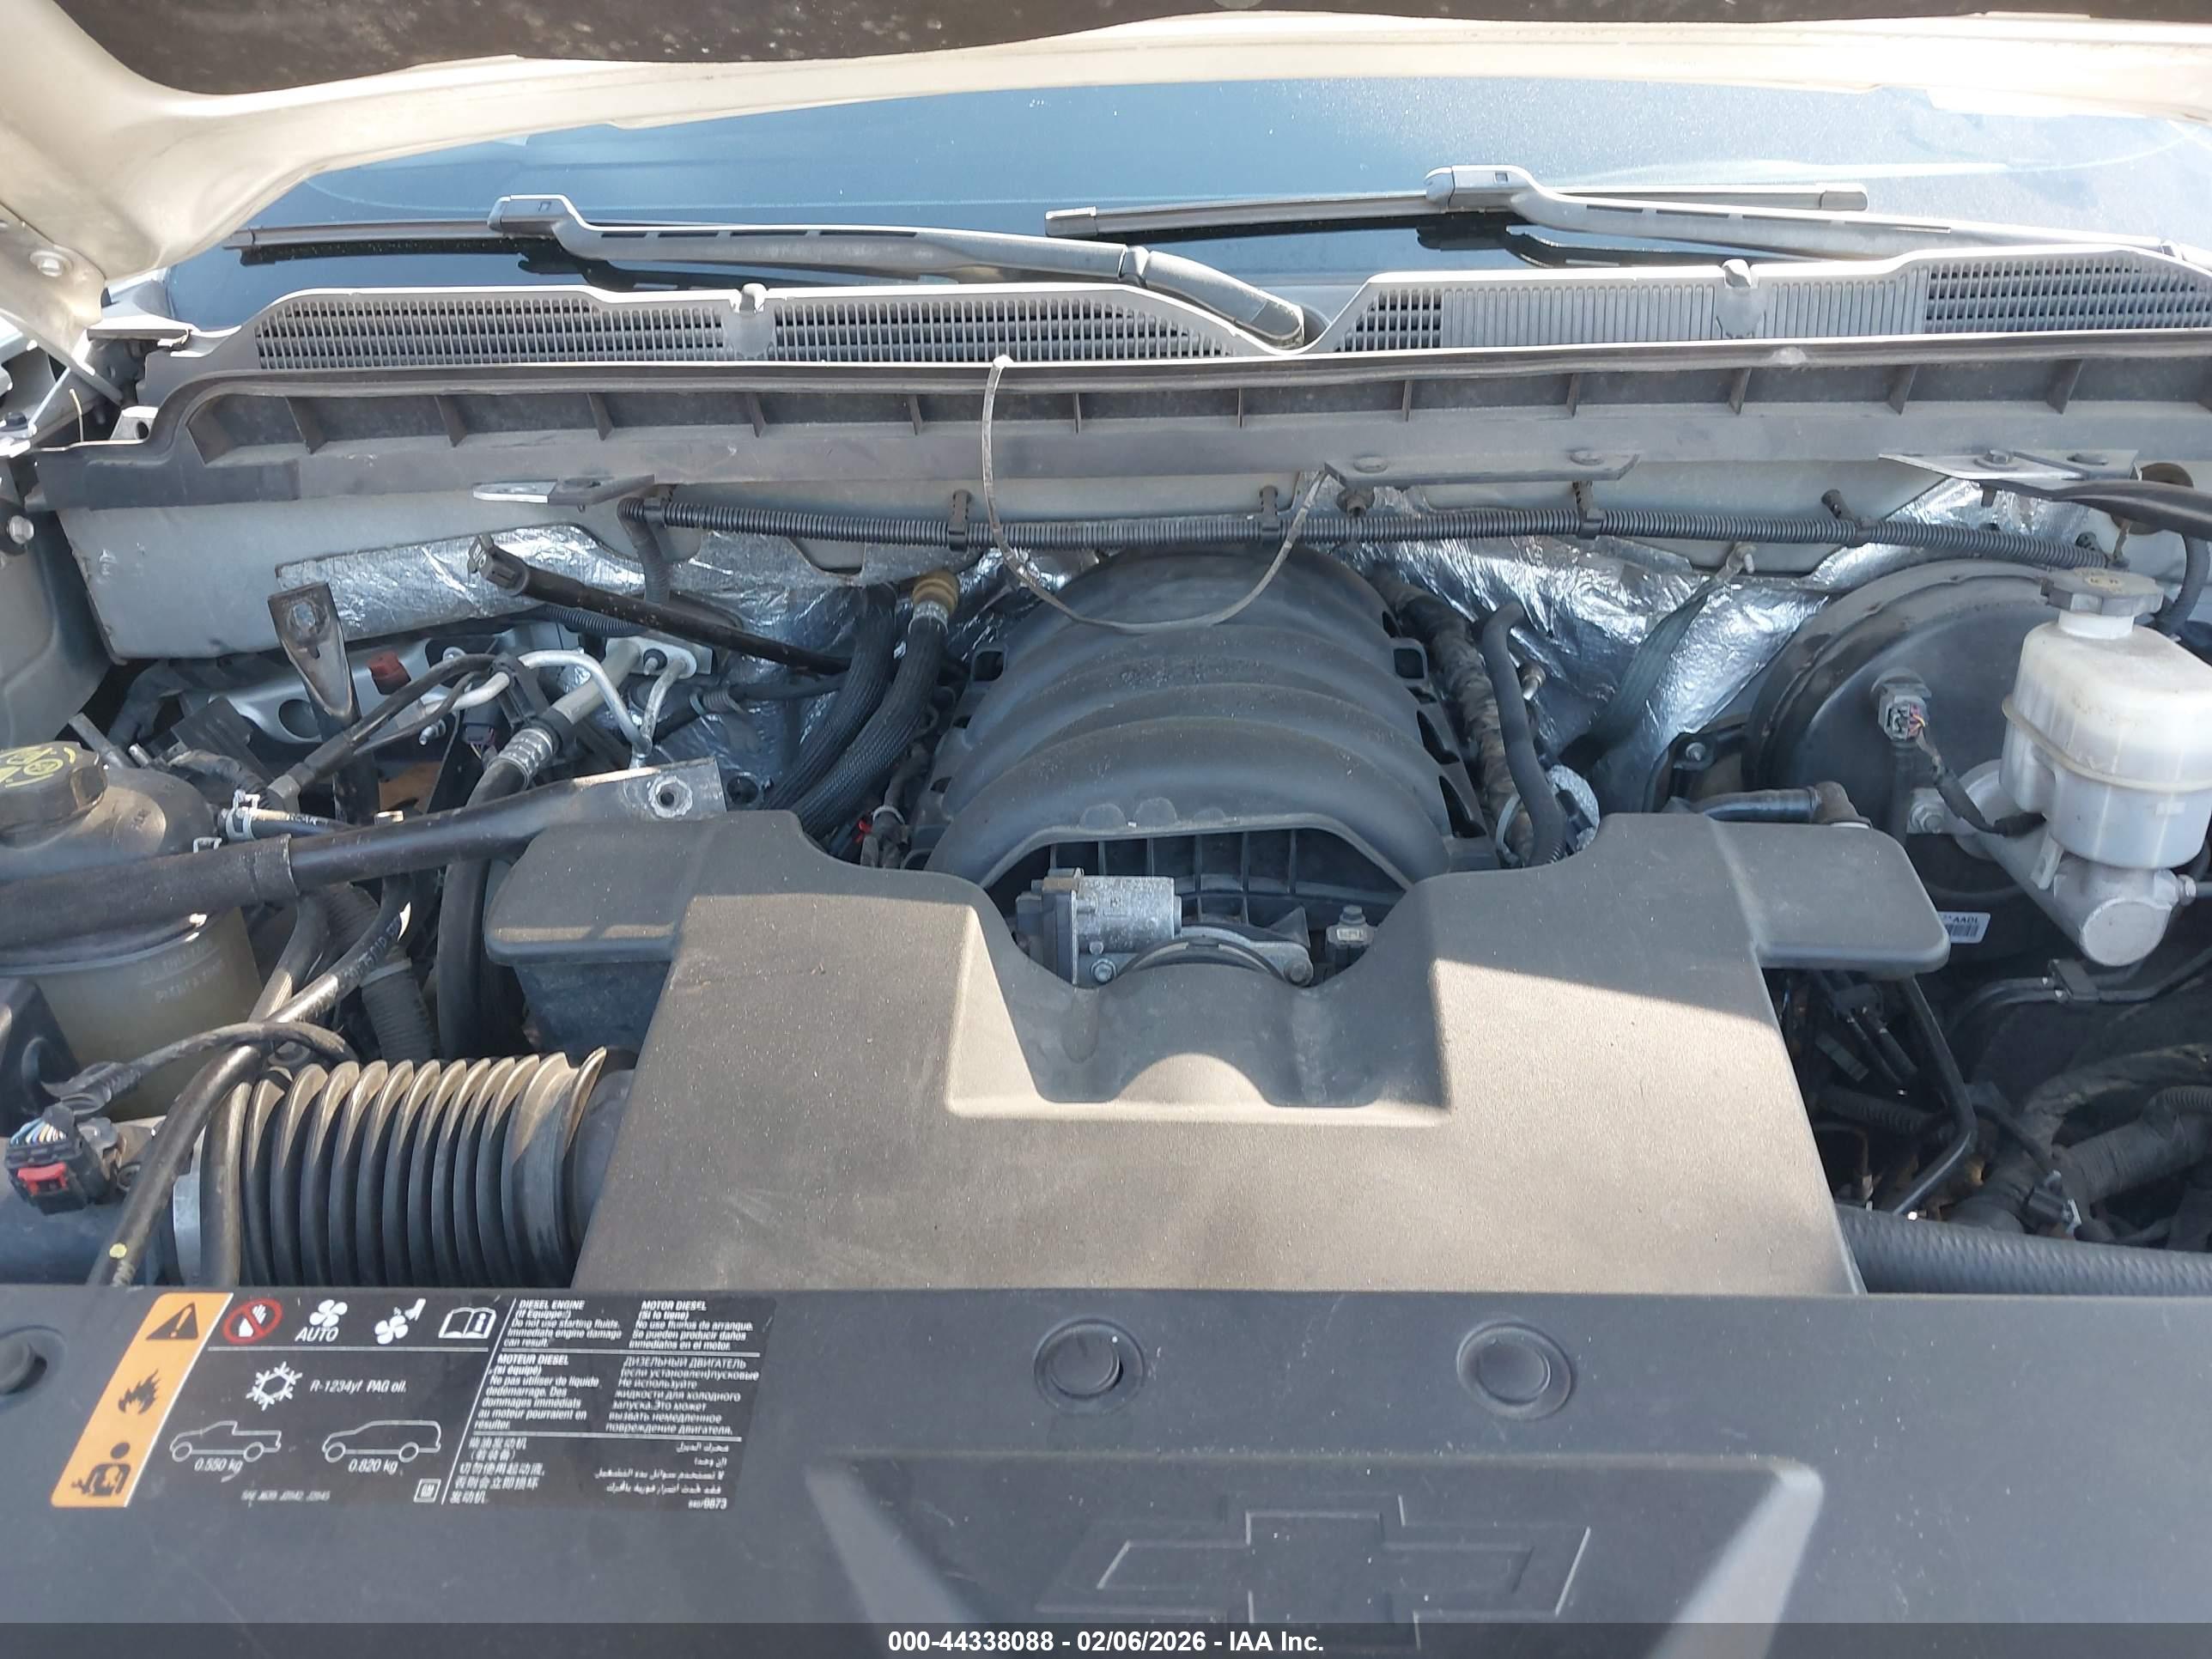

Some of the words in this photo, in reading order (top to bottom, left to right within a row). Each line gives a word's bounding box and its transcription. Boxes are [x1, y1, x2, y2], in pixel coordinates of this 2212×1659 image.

[519, 1299, 550, 1310] DIESEL
[551, 1300, 586, 1310] ENGINE
[641, 1300, 674, 1310] MOTOR
[675, 1301, 707, 1311] DIESEL
[511, 1318, 523, 1328] Do
[526, 1319, 538, 1328] not
[559, 1320, 592, 1329] starting
[635, 1320, 647, 1329] No
[698, 1321, 710, 1330] de
[295, 1327, 339, 1342] AUTO
[507, 1328, 553, 1338] Immediate
[555, 1330, 586, 1340] engine
[586, 1329, 623, 1340] damage
[645, 1330, 678, 1340] pueden
[679, 1331, 718, 1341] producir
[679, 1341, 691, 1350] en
[693, 1340, 702, 1350] el
[497, 1353, 536, 1364] MOTEUR
[537, 1354, 569, 1365] DIESEL
[489, 1376, 502, 1385] Ne
[503, 1377, 520, 1388] pas
[522, 1376, 553, 1386] utiliser
[555, 1376, 567, 1386] de
[550, 1387, 568, 1397] Des
[482, 1396, 532, 1408] dommages
[477, 1410, 490, 1419] au
[491, 1409, 524, 1419] moteur
[526, 1409, 574, 1420] pourraient
[574, 1411, 587, 1420] en
[228, 1458, 243, 1474] kg
[383, 1459, 398, 1475] kg
